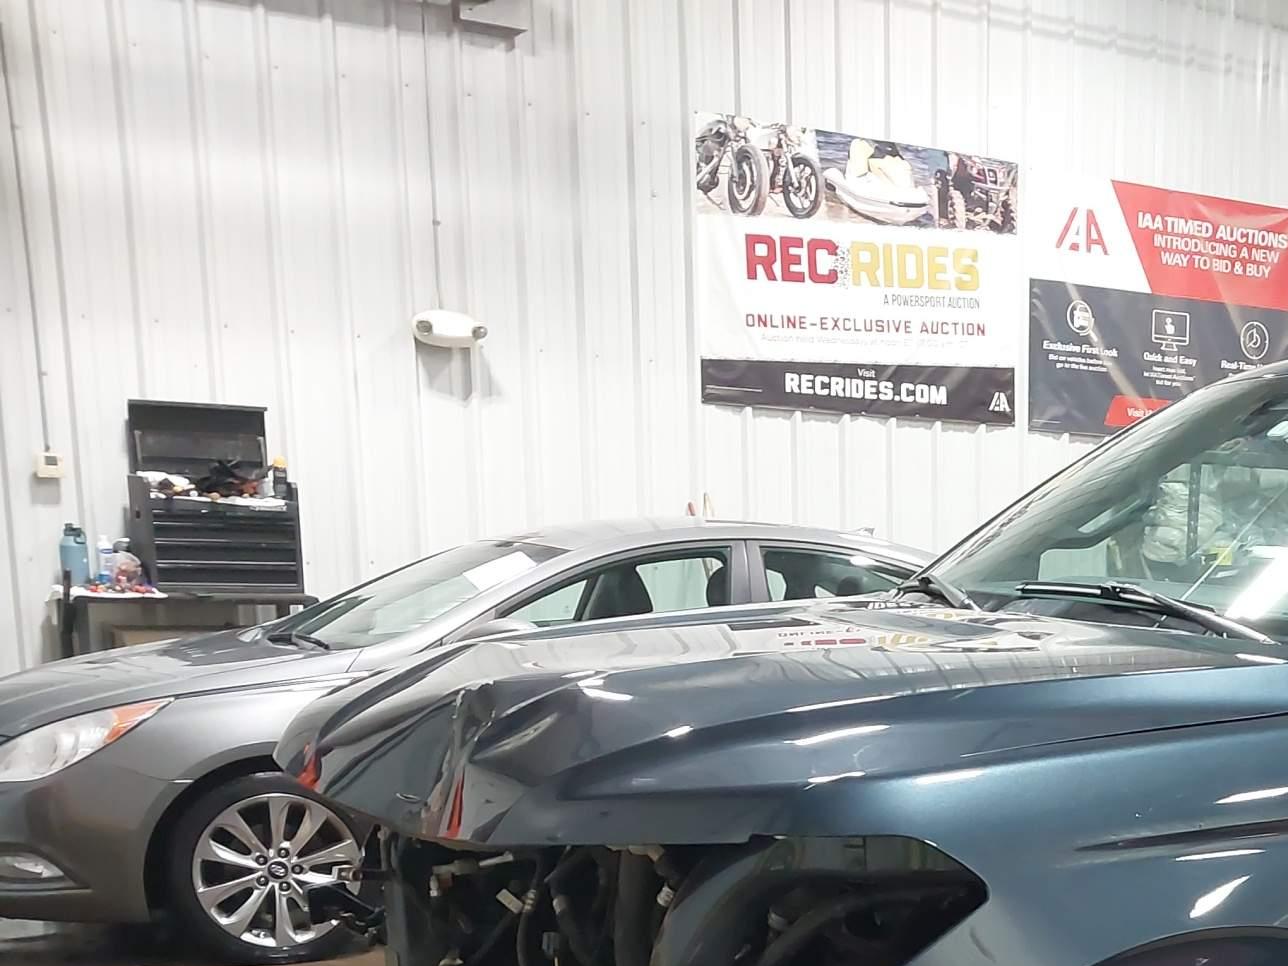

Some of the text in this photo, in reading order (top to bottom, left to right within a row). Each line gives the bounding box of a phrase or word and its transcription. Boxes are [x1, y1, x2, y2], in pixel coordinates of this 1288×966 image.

[1137, 211, 1163, 231] IAA
[1164, 216, 1213, 239] TIMED
[1153, 234, 1280, 264] INTRODUCING A NEW
[850, 240, 980, 292] RIDES
[1160, 251, 1271, 279] WAY TO BID & BUY
[883, 293, 980, 310] A POWERSPORT AUCTION
[745, 313, 986, 337] ONLINE-EXCLUSIVE AUCTION
[857, 367, 877, 379] Visit
[784, 372, 948, 406] RECRIDES.COM
